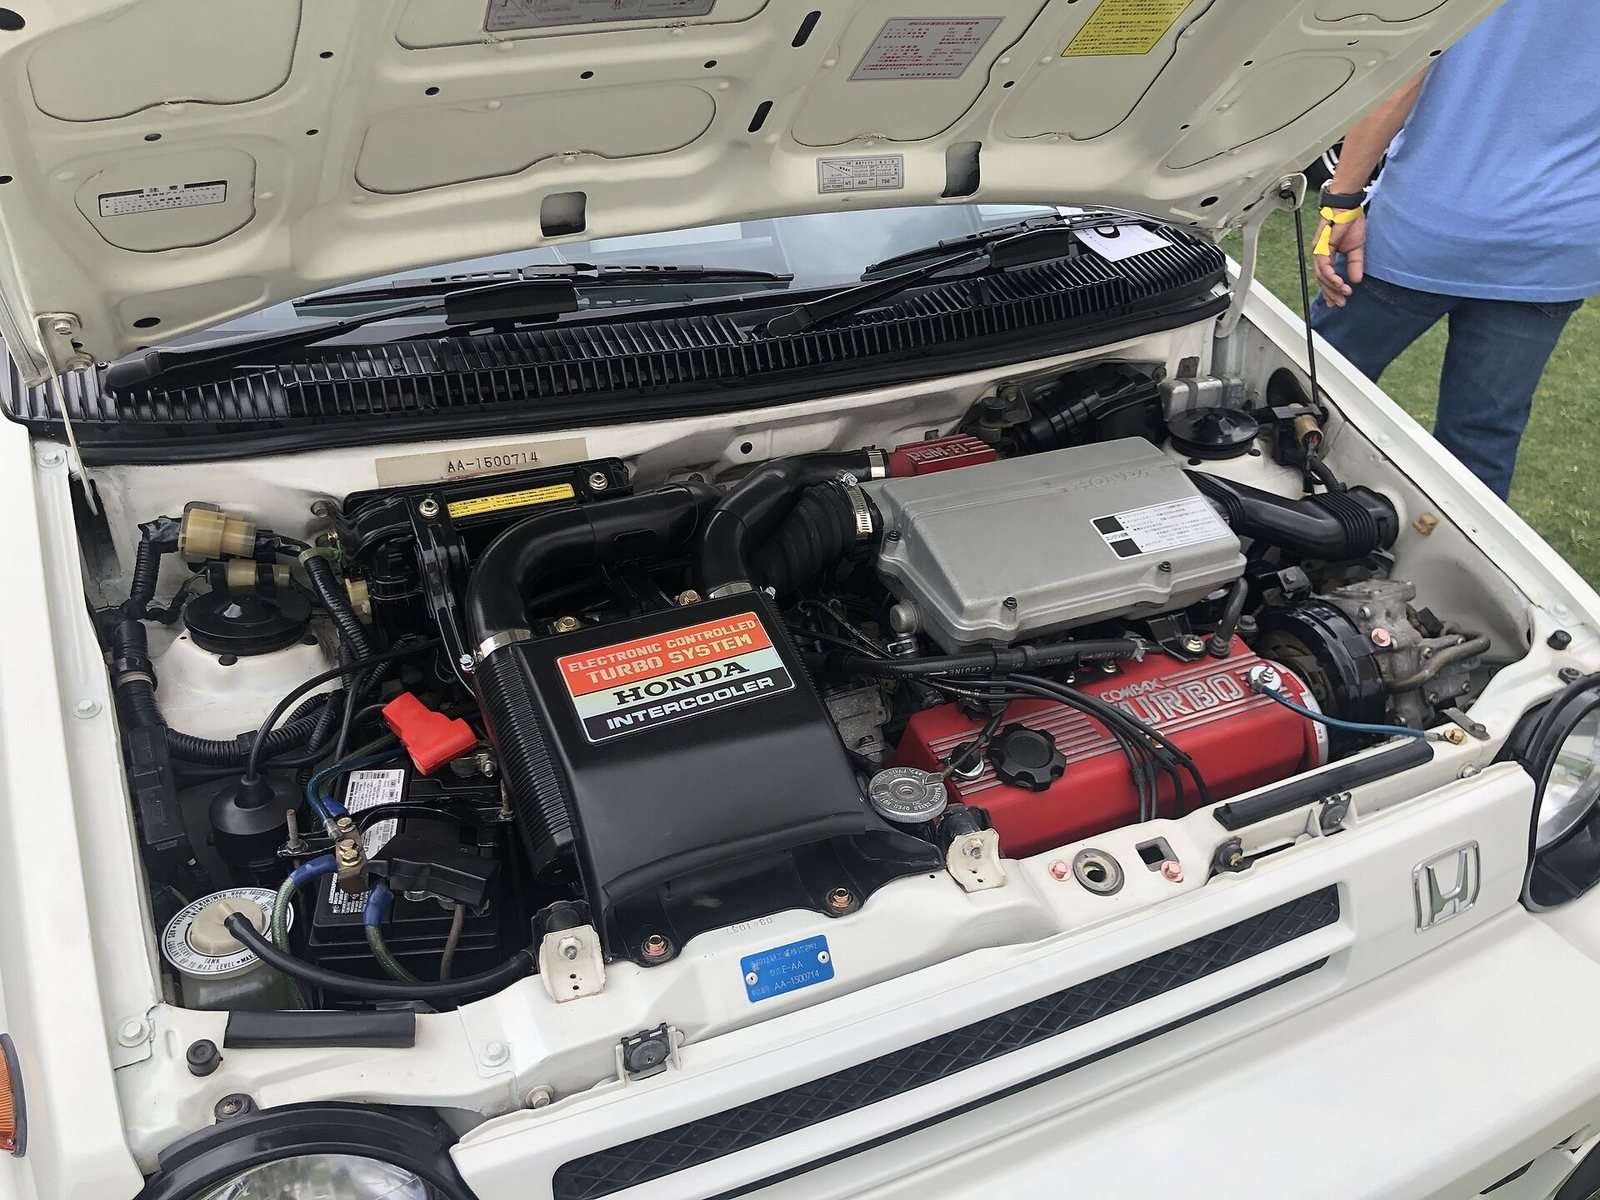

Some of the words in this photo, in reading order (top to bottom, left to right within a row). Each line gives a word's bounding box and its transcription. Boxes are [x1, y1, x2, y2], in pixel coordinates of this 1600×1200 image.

[447, 451, 539, 473] AA-1500714
[906, 443, 969, 462] PGM-FI
[568, 642, 663, 674] ELECTRONIC
[666, 619, 757, 649] CONTROLLED
[585, 656, 664, 685] TURBO
[667, 634, 753, 665] SYSTEM
[606, 675, 775, 730] INTERCOOLER
[612, 660, 751, 706] HONDA
[1100, 678, 1165, 702] COMBAX
[1114, 673, 1245, 725] URBO
